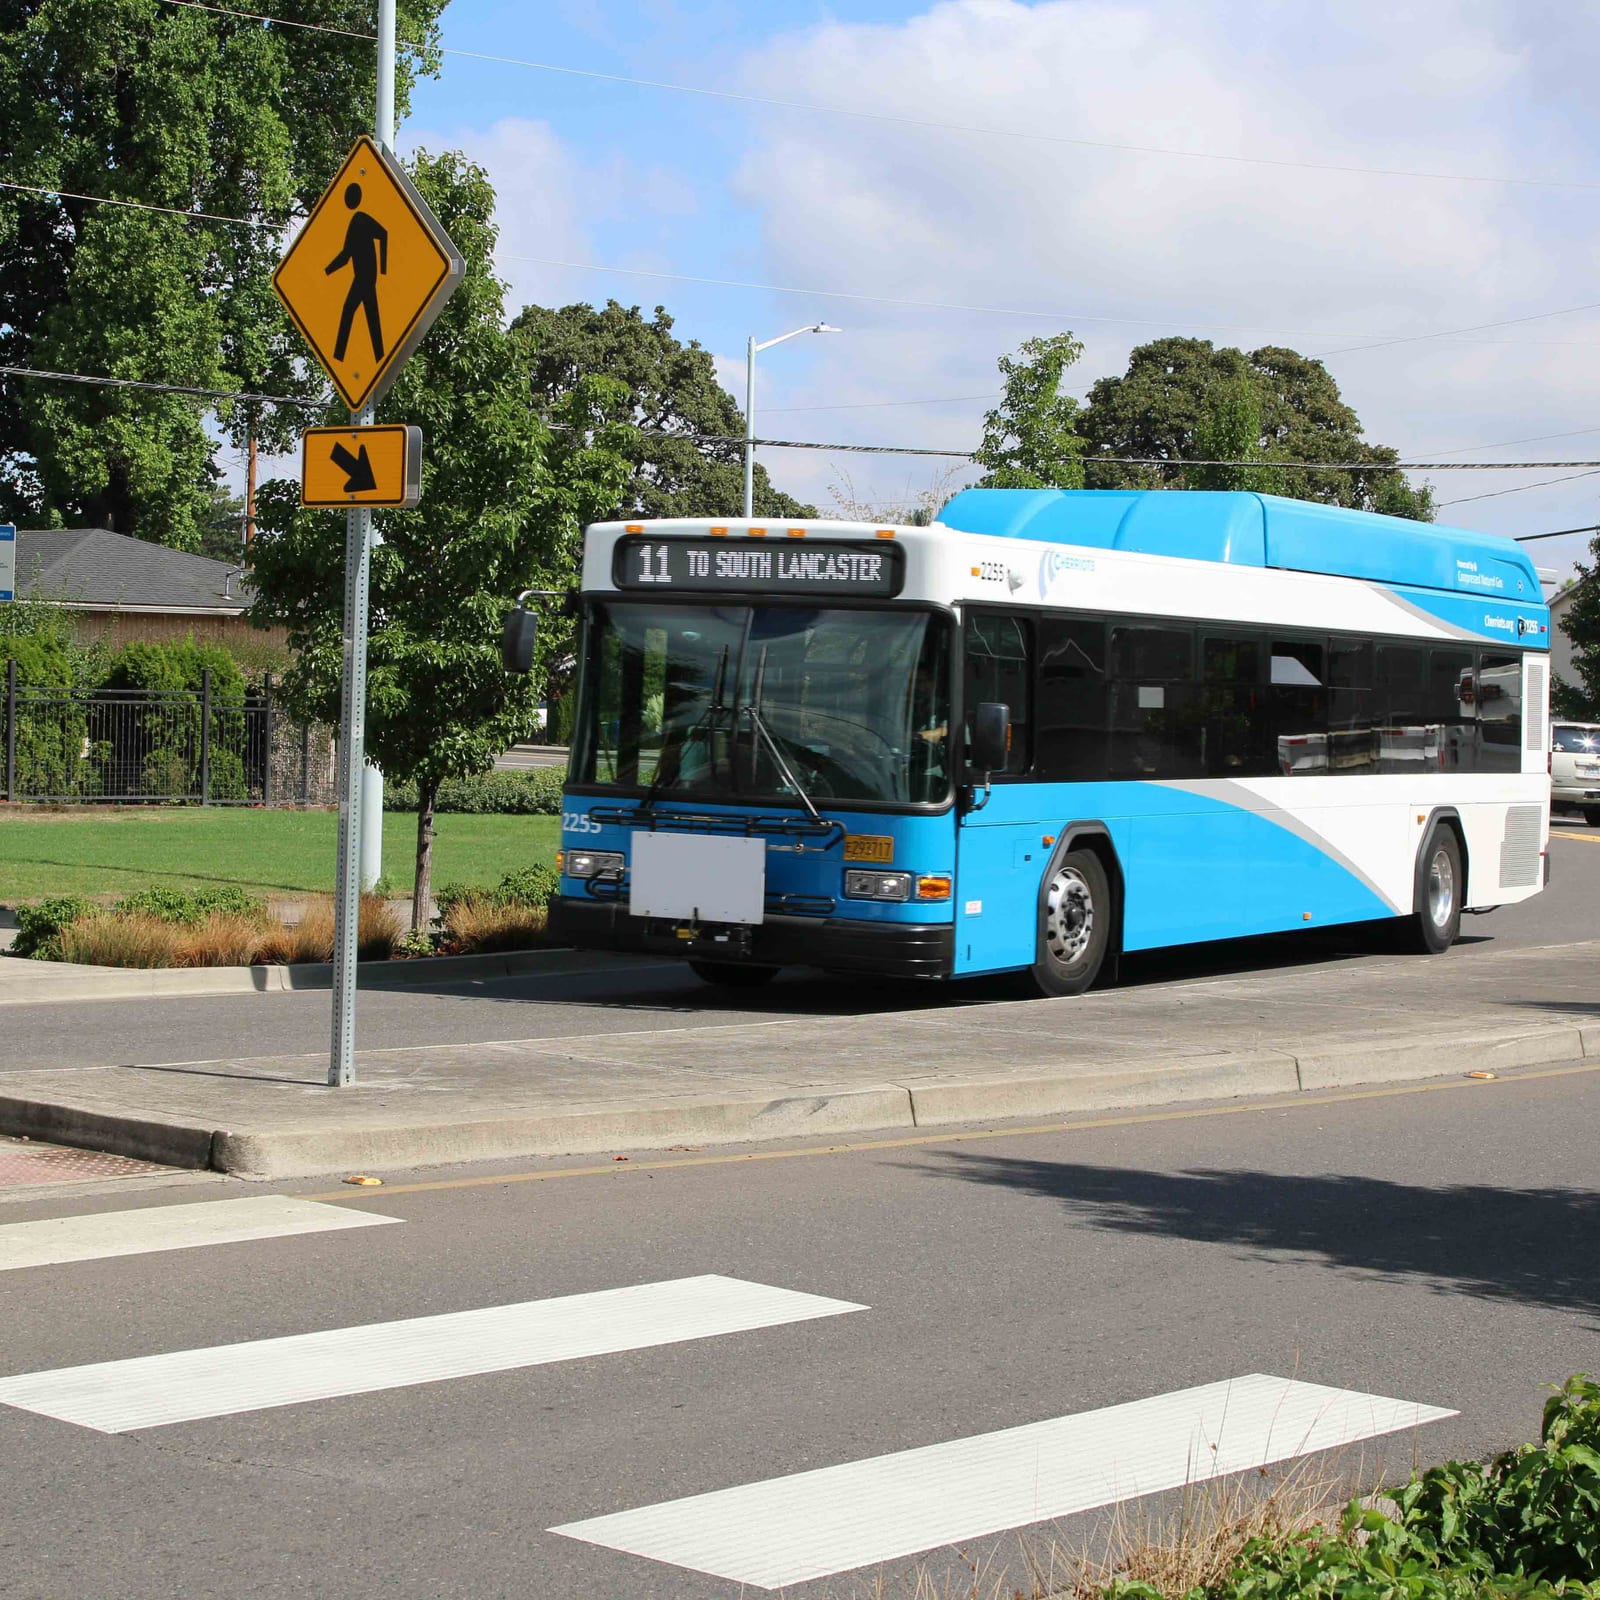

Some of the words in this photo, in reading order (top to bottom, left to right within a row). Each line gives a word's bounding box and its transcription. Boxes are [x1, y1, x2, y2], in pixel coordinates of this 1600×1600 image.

[638, 545, 672, 583] 11
[687, 550, 710, 577] TO
[715, 551, 771, 579] SOUTH
[777, 552, 882, 581] LANCASTER
[981, 561, 1004, 582] 2255
[561, 812, 602, 834] 2255
